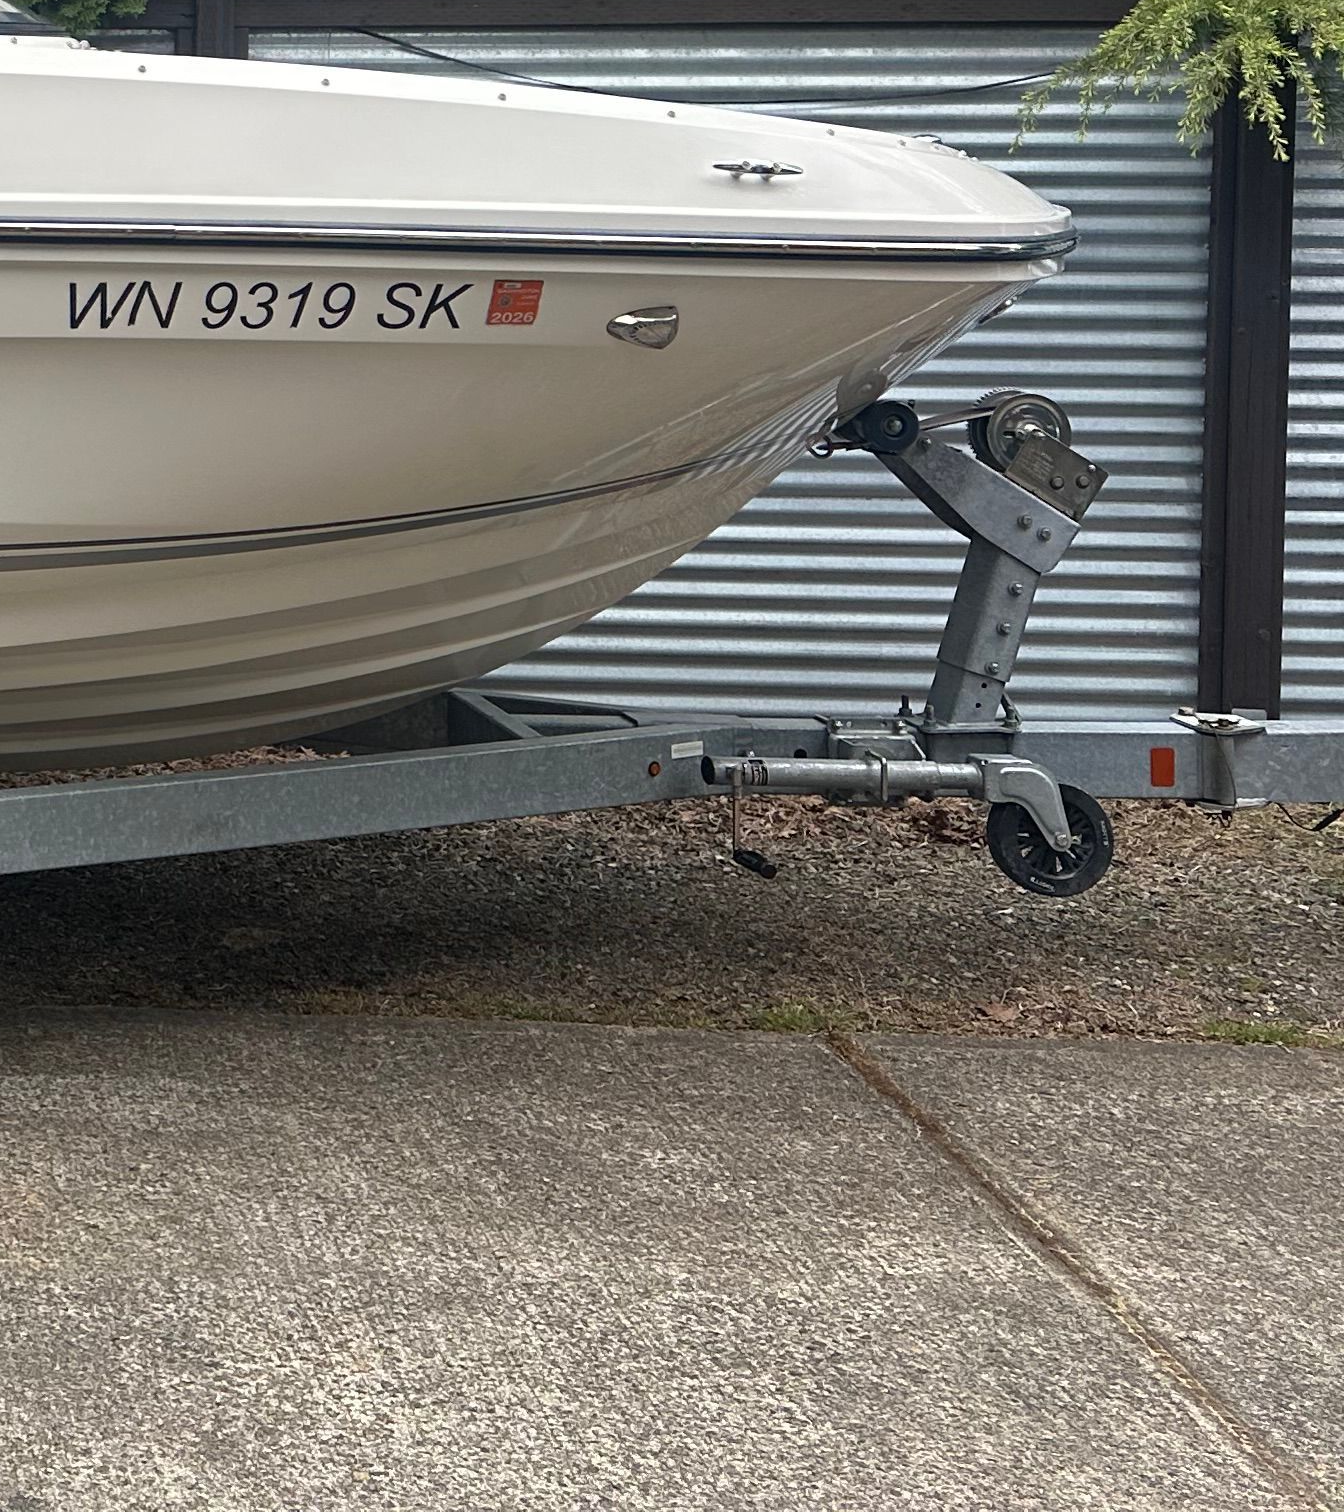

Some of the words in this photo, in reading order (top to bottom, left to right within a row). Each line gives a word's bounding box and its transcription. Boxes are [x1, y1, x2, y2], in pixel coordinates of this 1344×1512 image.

[70, 281, 182, 329] WN
[202, 282, 355, 329] 9319
[377, 283, 474, 329] SK
[489, 312, 534, 324] 2026
